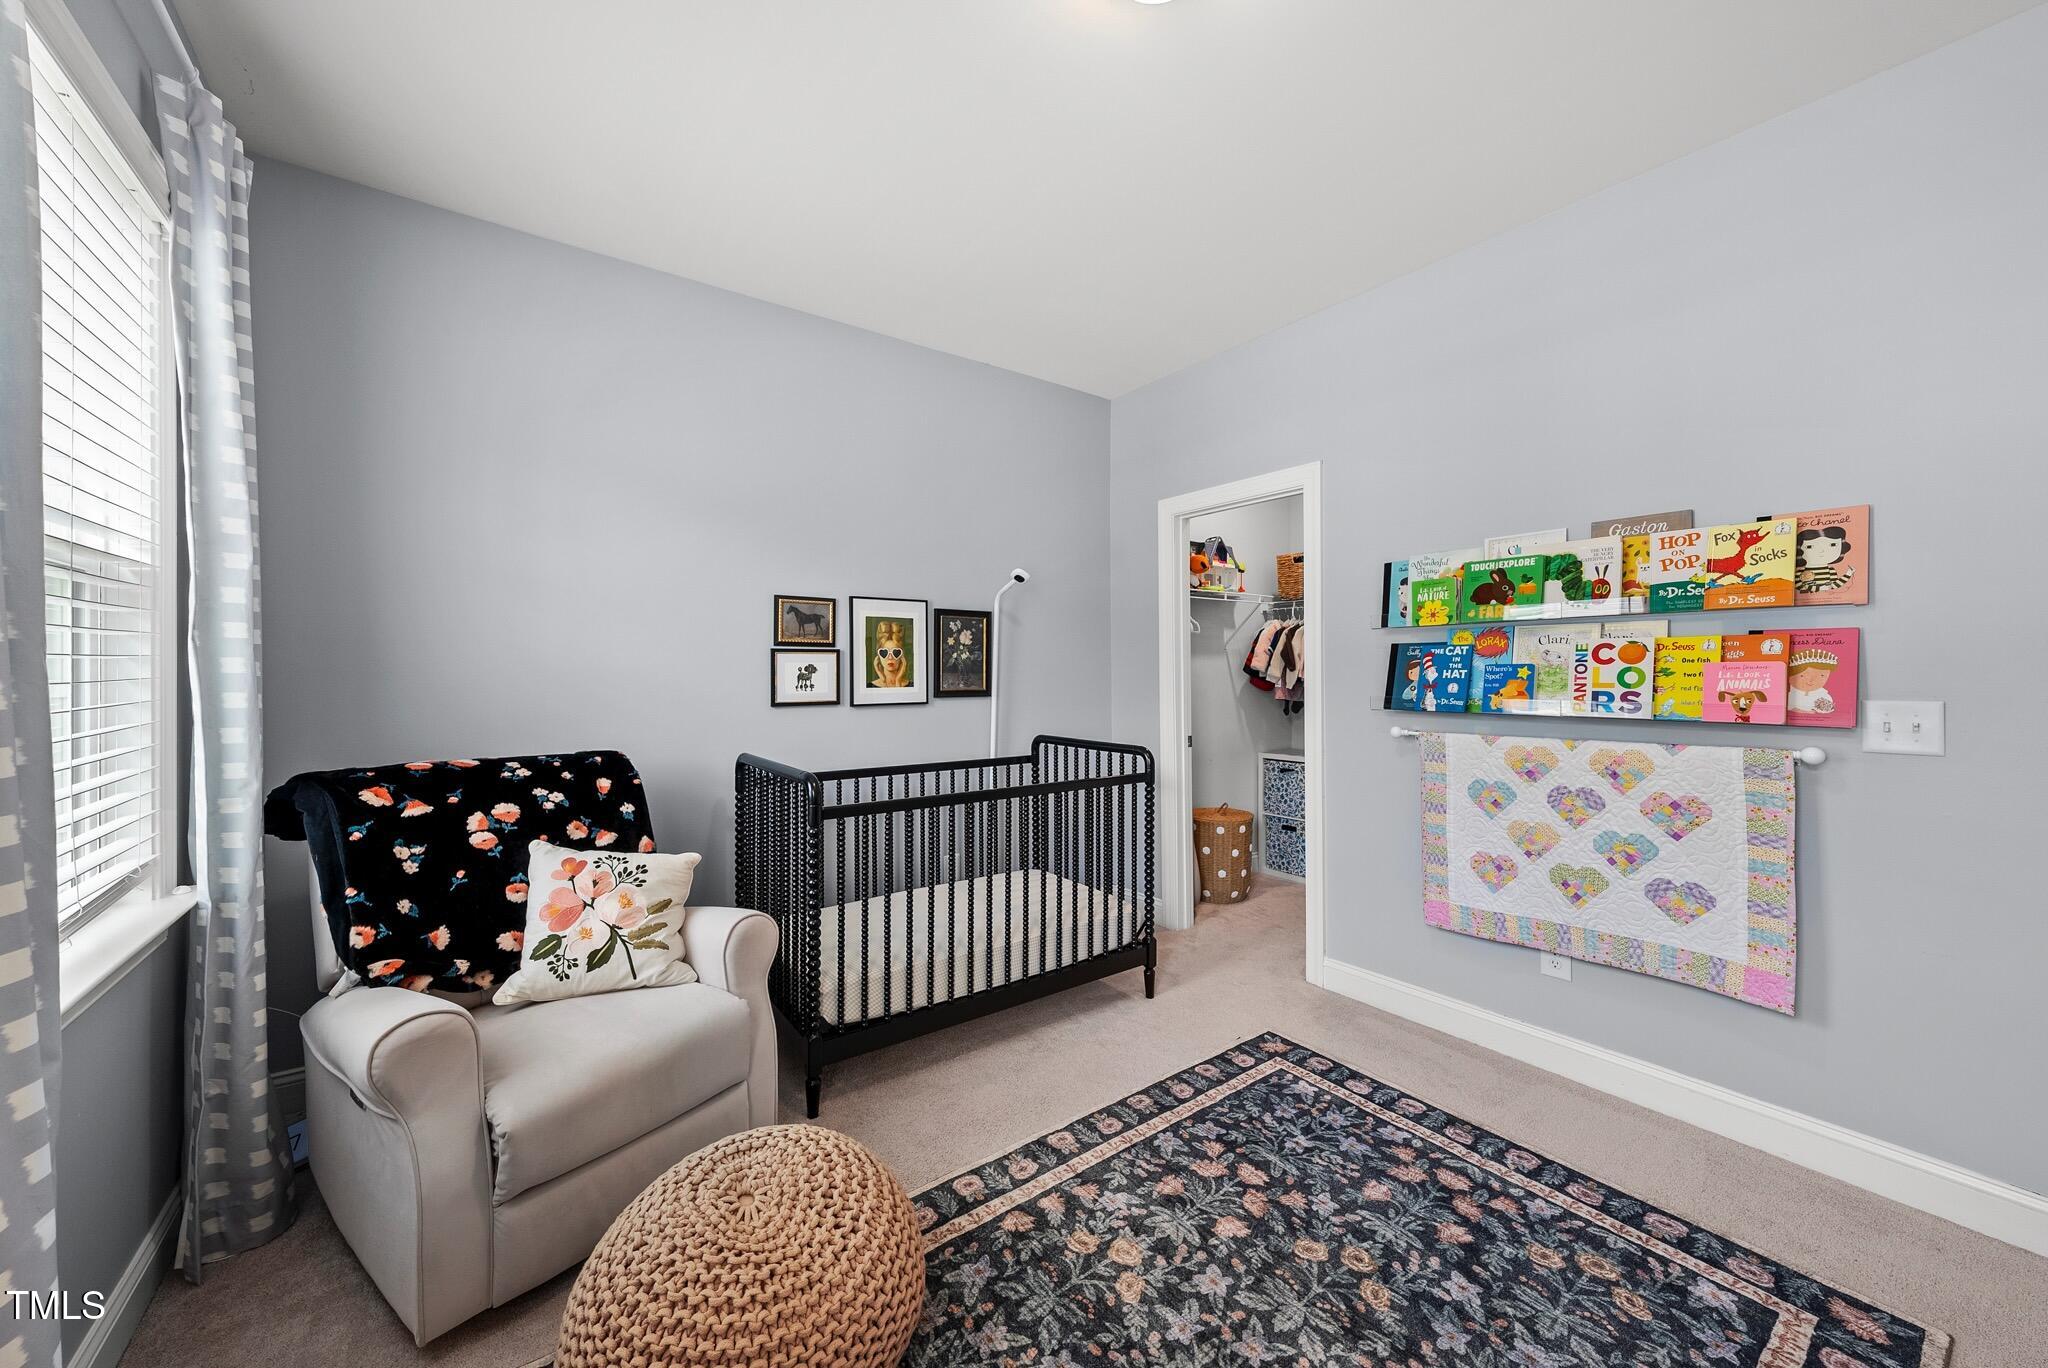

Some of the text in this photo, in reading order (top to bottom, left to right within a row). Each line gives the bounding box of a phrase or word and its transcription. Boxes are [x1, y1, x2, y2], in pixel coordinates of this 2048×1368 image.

[1811, 515, 1851, 527] Chanel
[1608, 520, 1669, 537] Gaston
[1658, 532, 1702, 550] HOP
[1714, 532, 1736, 546] Fox
[1659, 554, 1701, 572] POP
[1749, 548, 1788, 566] Socks
[1471, 562, 1495, 572] TOUCH
[1499, 557, 1536, 569] EXPLORE
[1417, 591, 1450, 602] NATURE
[1667, 587, 1685, 598] Dr.
[1686, 584, 1705, 596] Seu
[1728, 595, 1745, 604] Dr.
[1747, 594, 1776, 603] Seuss
[1478, 604, 1505, 619] FAR
[1476, 636, 1508, 649] LORAX
[1538, 634, 1570, 645] Clari
[1446, 646, 1469, 655] CAT
[1656, 642, 1696, 652] Dr. Seuss
[1442, 669, 1468, 679] HAT
[1485, 673, 1504, 681] Spot?
[1573, 642, 1589, 713] PANTONE
[1717, 678, 1772, 692] ANIMALS
